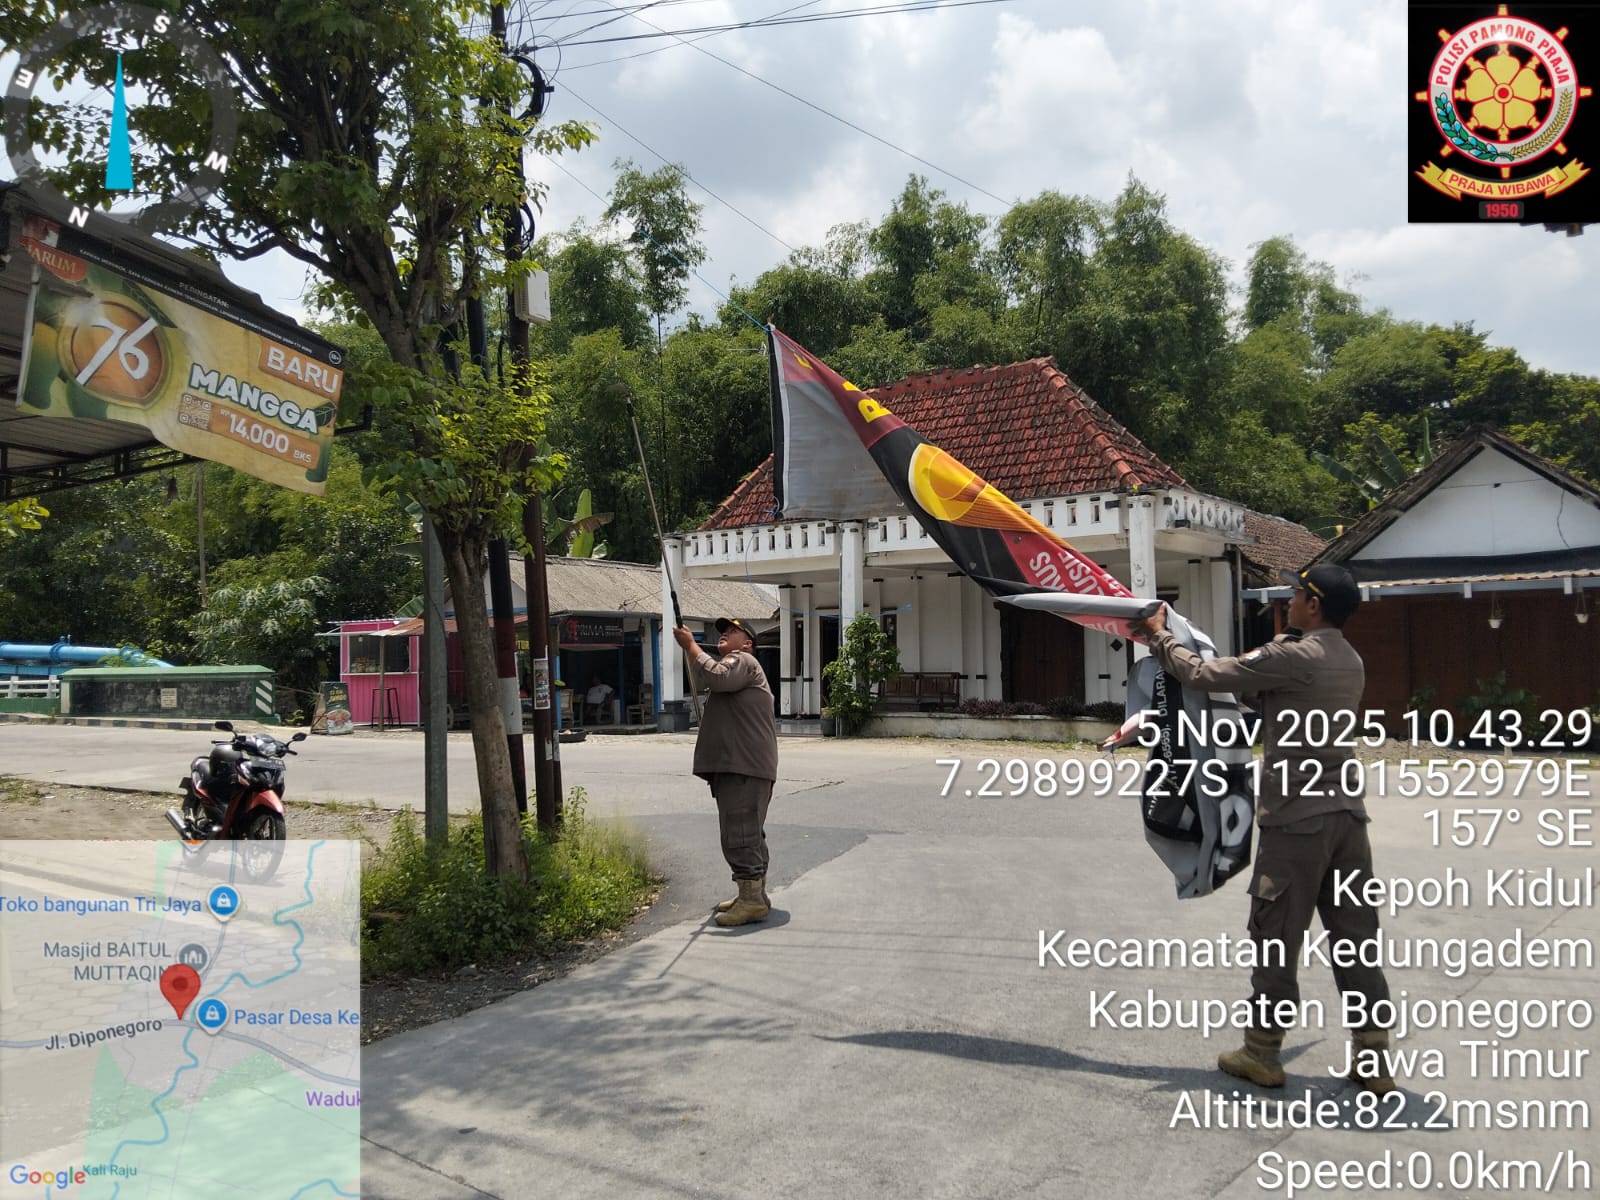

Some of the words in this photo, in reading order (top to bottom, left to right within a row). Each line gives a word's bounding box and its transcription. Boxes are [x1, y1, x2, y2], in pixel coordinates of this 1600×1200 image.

[75, 316, 159, 387] 76
[267, 346, 339, 393] BARU
[190, 363, 319, 434] MANGGA
[229, 413, 289, 453] 14.000
[293, 449, 312, 462] BKS
